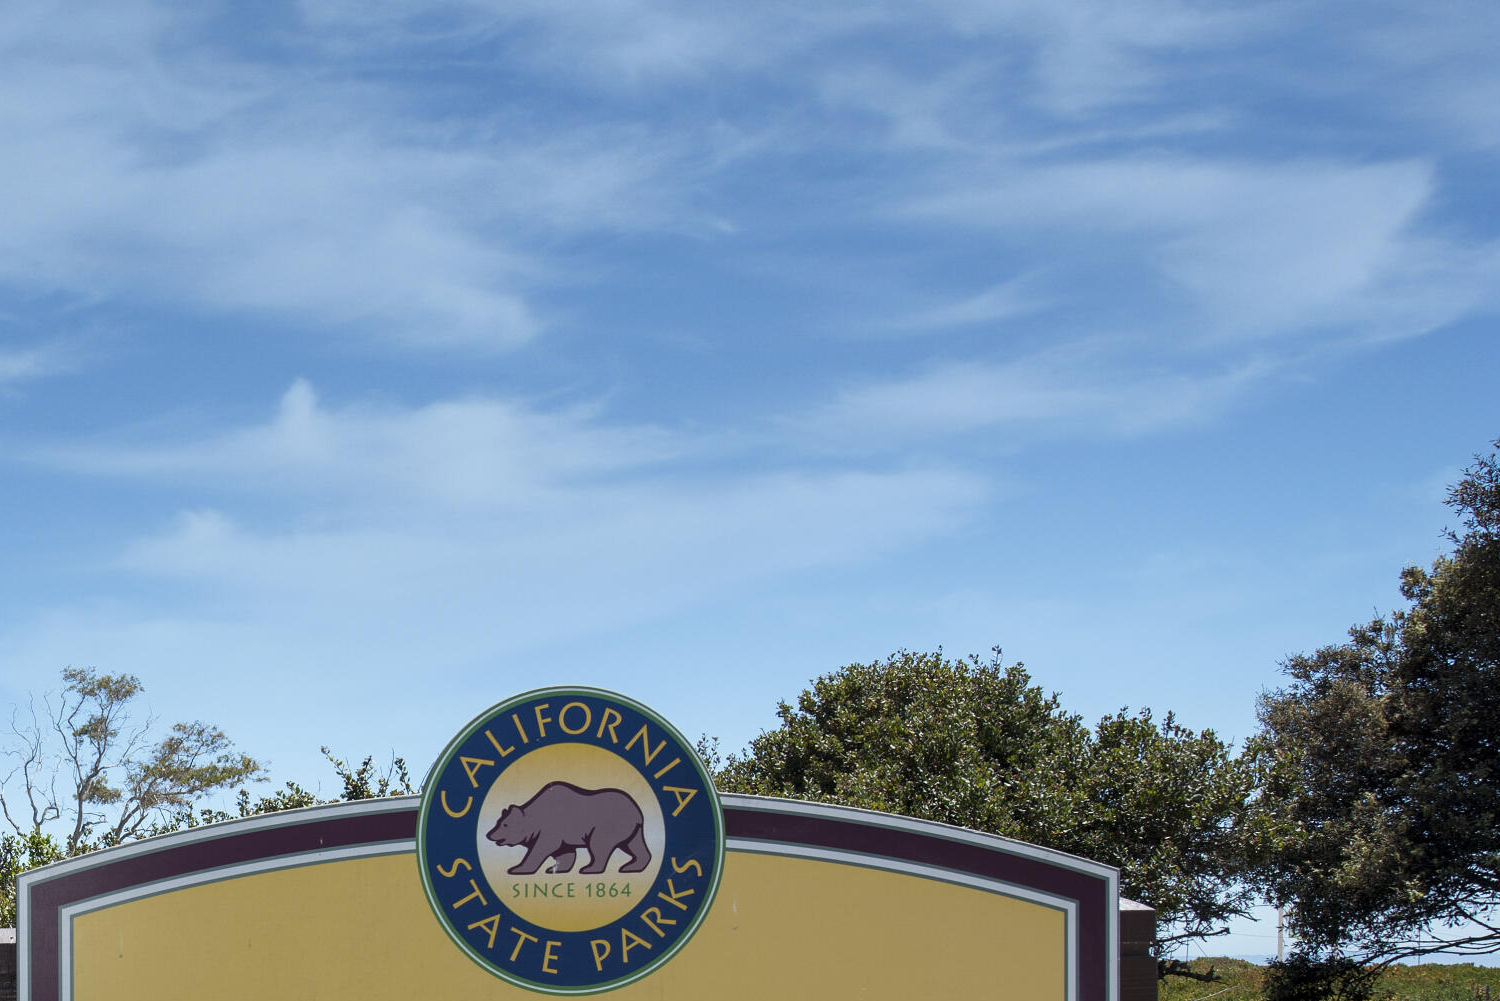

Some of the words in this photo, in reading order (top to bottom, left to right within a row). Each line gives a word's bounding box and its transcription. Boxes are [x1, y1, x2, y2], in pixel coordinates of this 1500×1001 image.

[441, 701, 698, 818] CALIFORNIA
[437, 858, 562, 974] STATE
[590, 857, 703, 972] PARKS
[512, 882, 576, 899] SINCE
[585, 882, 632, 898] 1864
